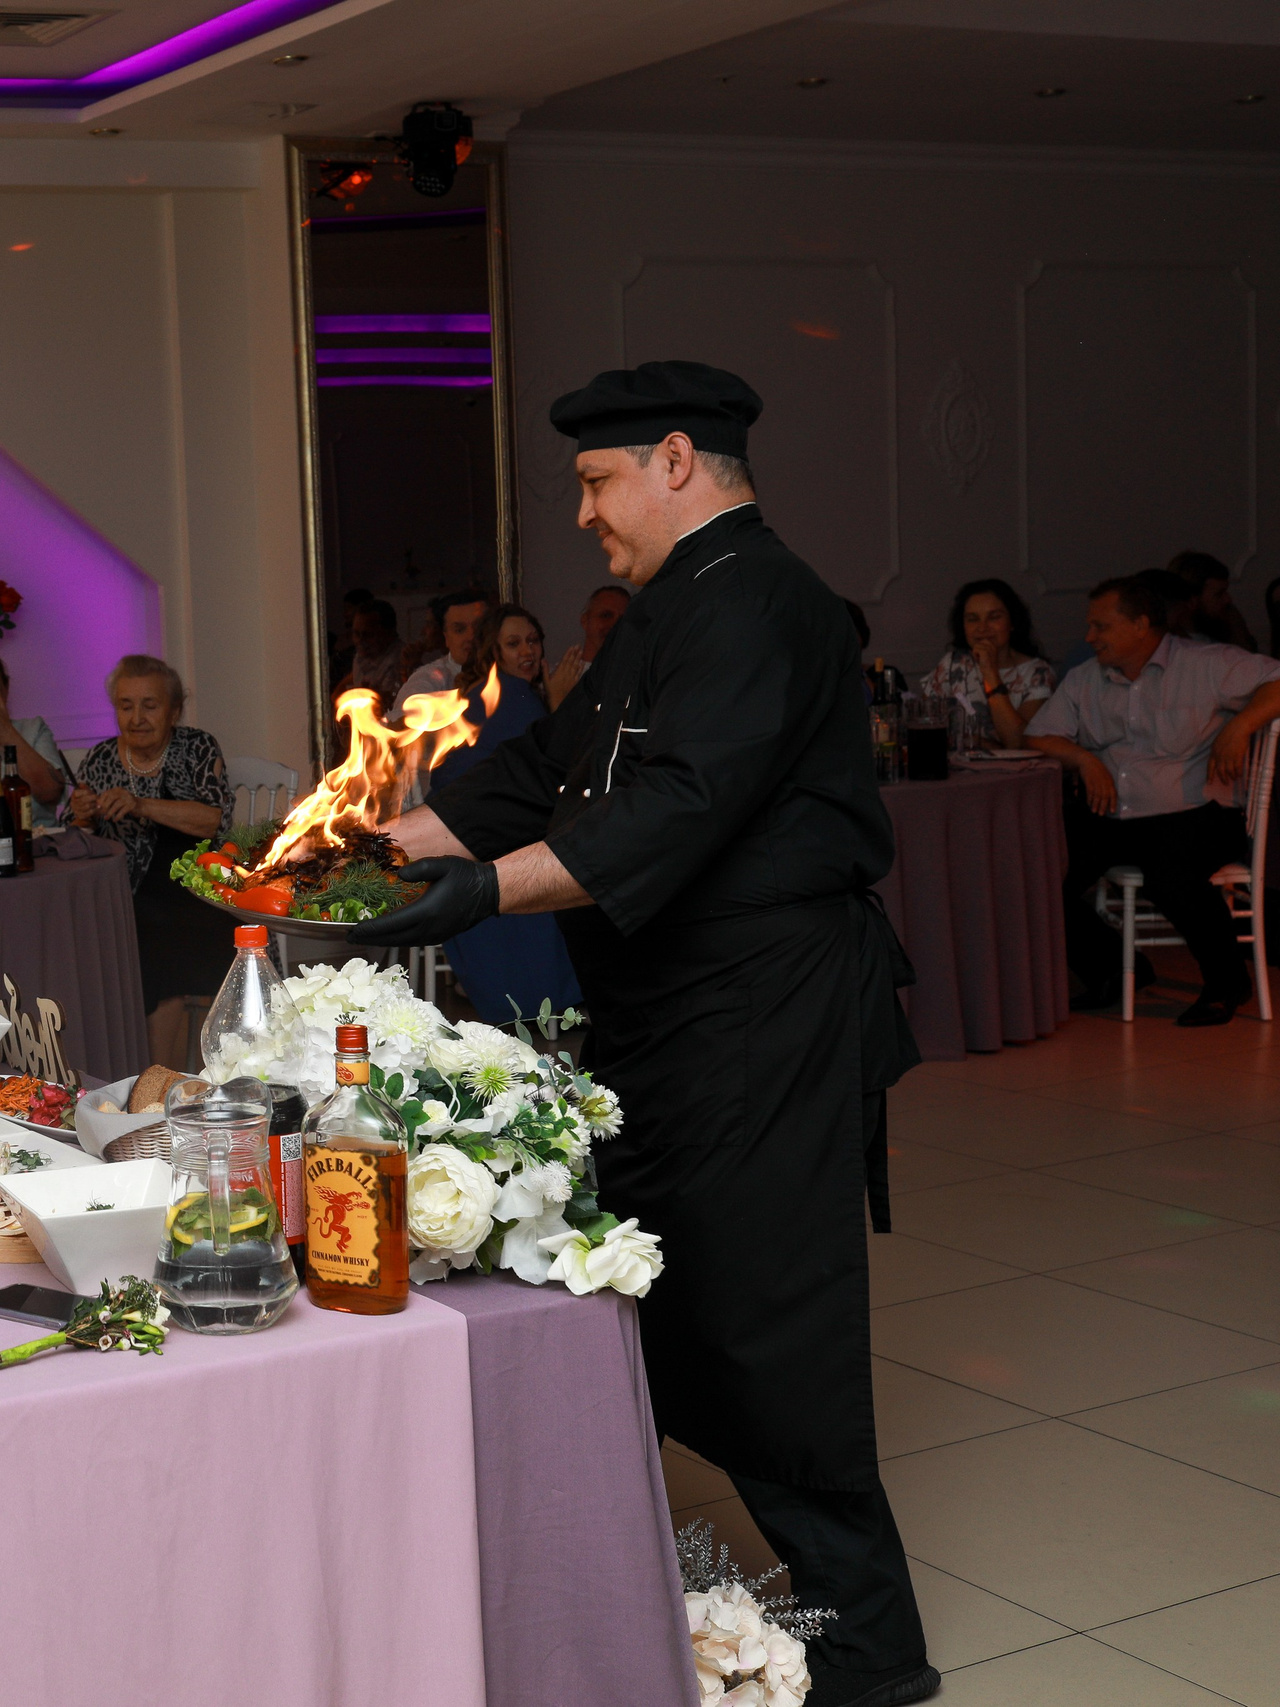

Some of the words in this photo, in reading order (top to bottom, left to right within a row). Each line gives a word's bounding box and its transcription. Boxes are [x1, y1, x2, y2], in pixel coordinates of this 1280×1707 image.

[307, 1157, 373, 1189] FIREBALL
[311, 1250, 342, 1264] CINNAMON
[342, 1255, 370, 1267] WHISKY
